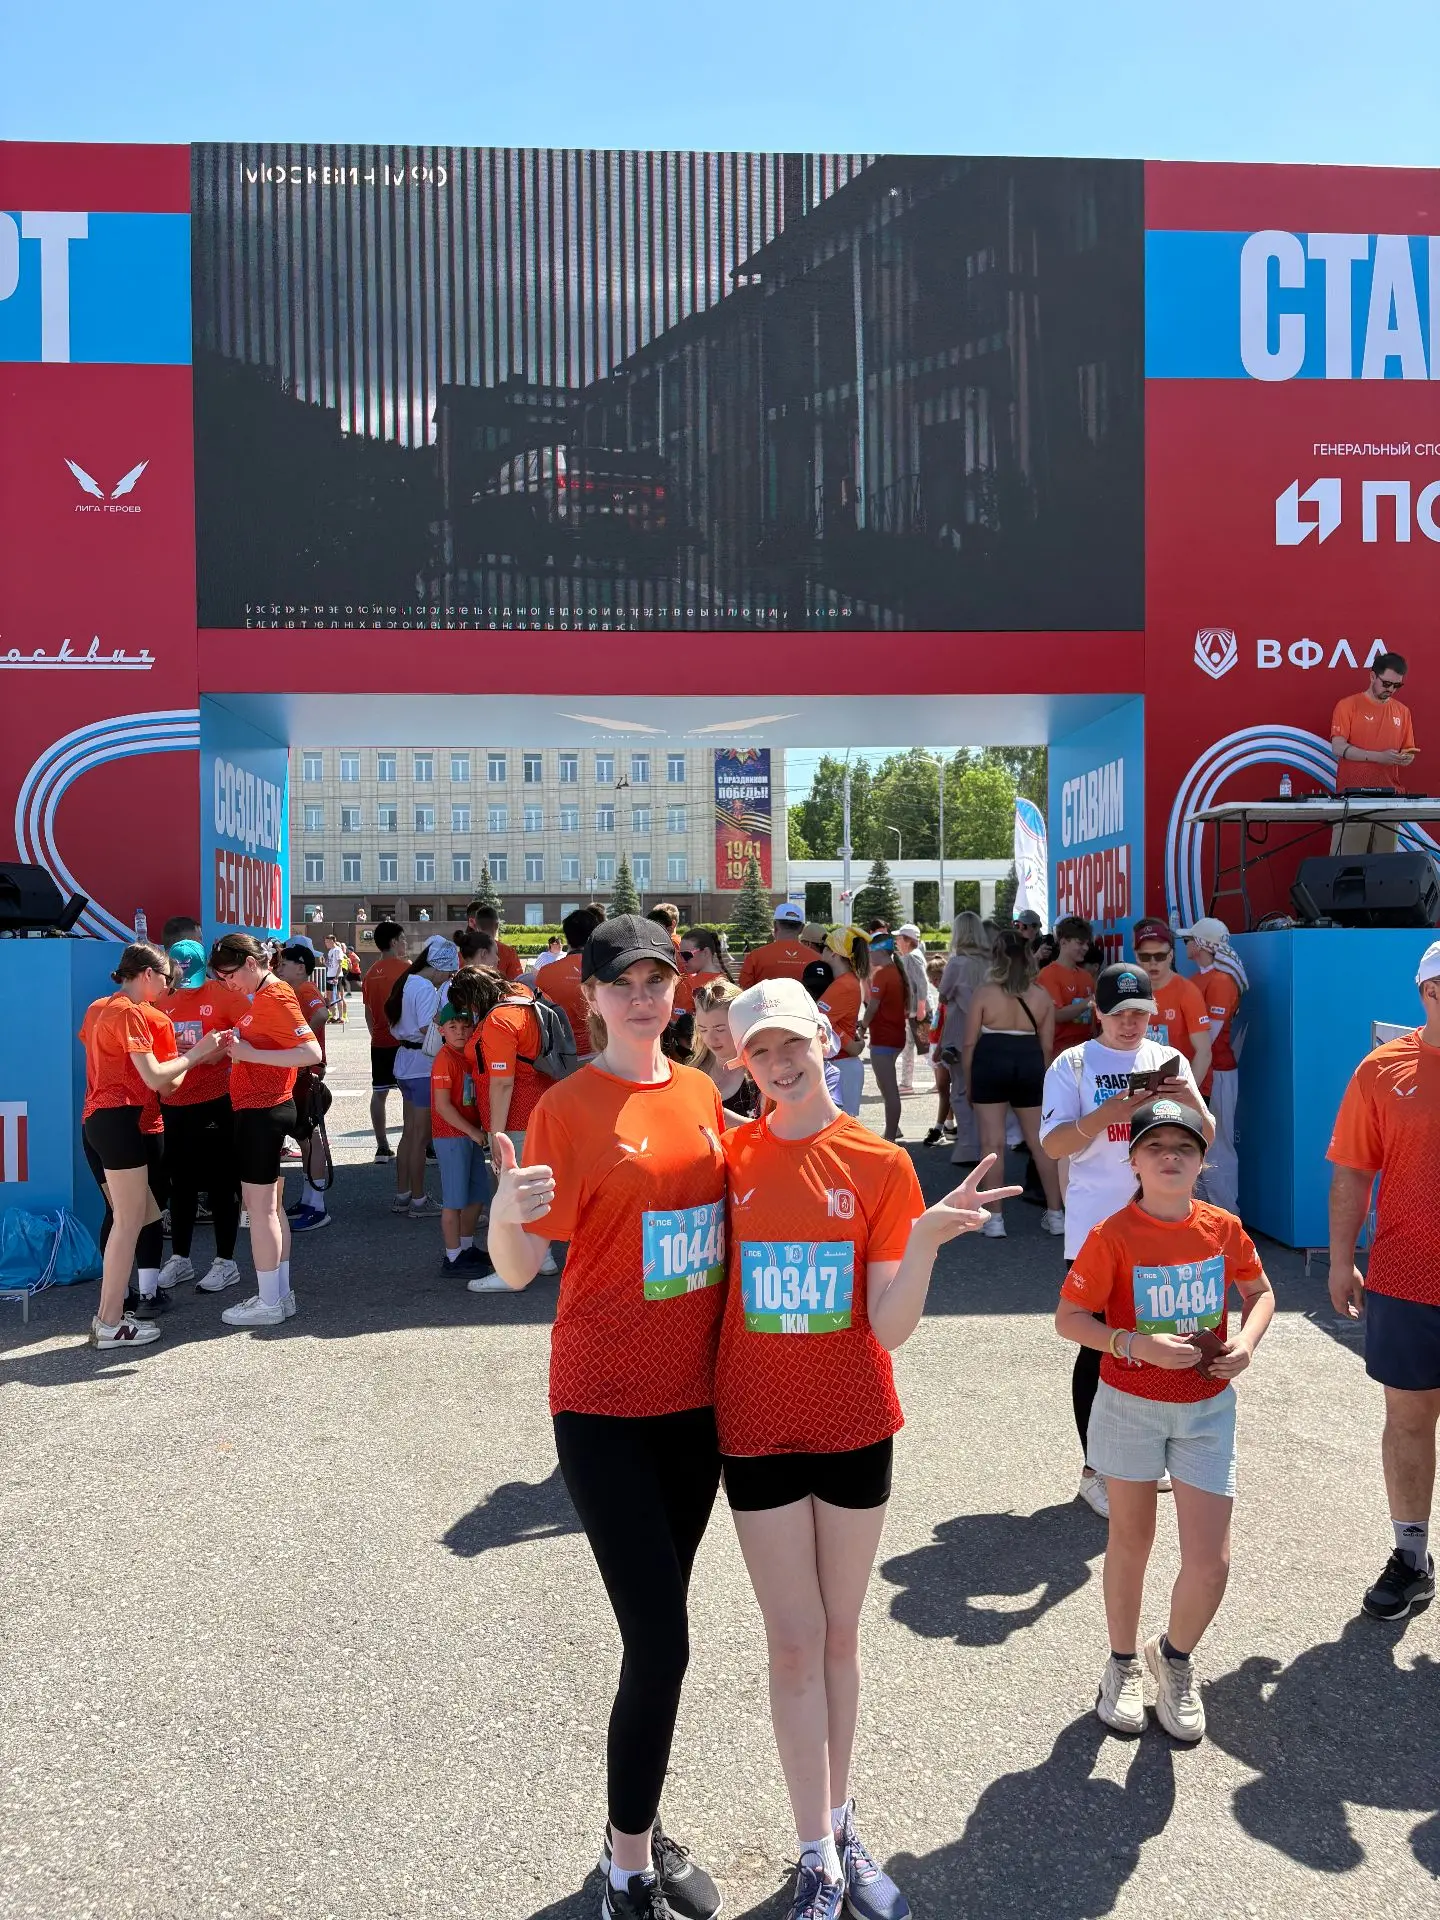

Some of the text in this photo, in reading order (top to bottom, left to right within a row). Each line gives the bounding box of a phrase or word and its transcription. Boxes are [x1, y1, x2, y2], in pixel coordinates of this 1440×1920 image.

[1241, 230, 1440, 381] СТА
[1313, 442, 1411, 456] ГЕНЕРАЛЬНЫЙ
[75, 505, 141, 513] ЛИГА ГЕРОЕВ
[0, 635, 155, 664] осквич
[718, 776, 769, 785] С ПРАЗДНИКОМ
[214, 757, 282, 853] СОЗДАЕМ
[1062, 757, 1124, 848] СТАВИМ
[726, 840, 761, 860] 1941
[215, 848, 282, 930] БЕГОВУЮ
[1056, 843, 1131, 928] РЕКОРДЫ
[656, 1219, 672, 1227] ПСБ
[660, 1222, 725, 1276] 10448
[752, 1266, 838, 1310] 10347
[1147, 1277, 1218, 1318] 10484
